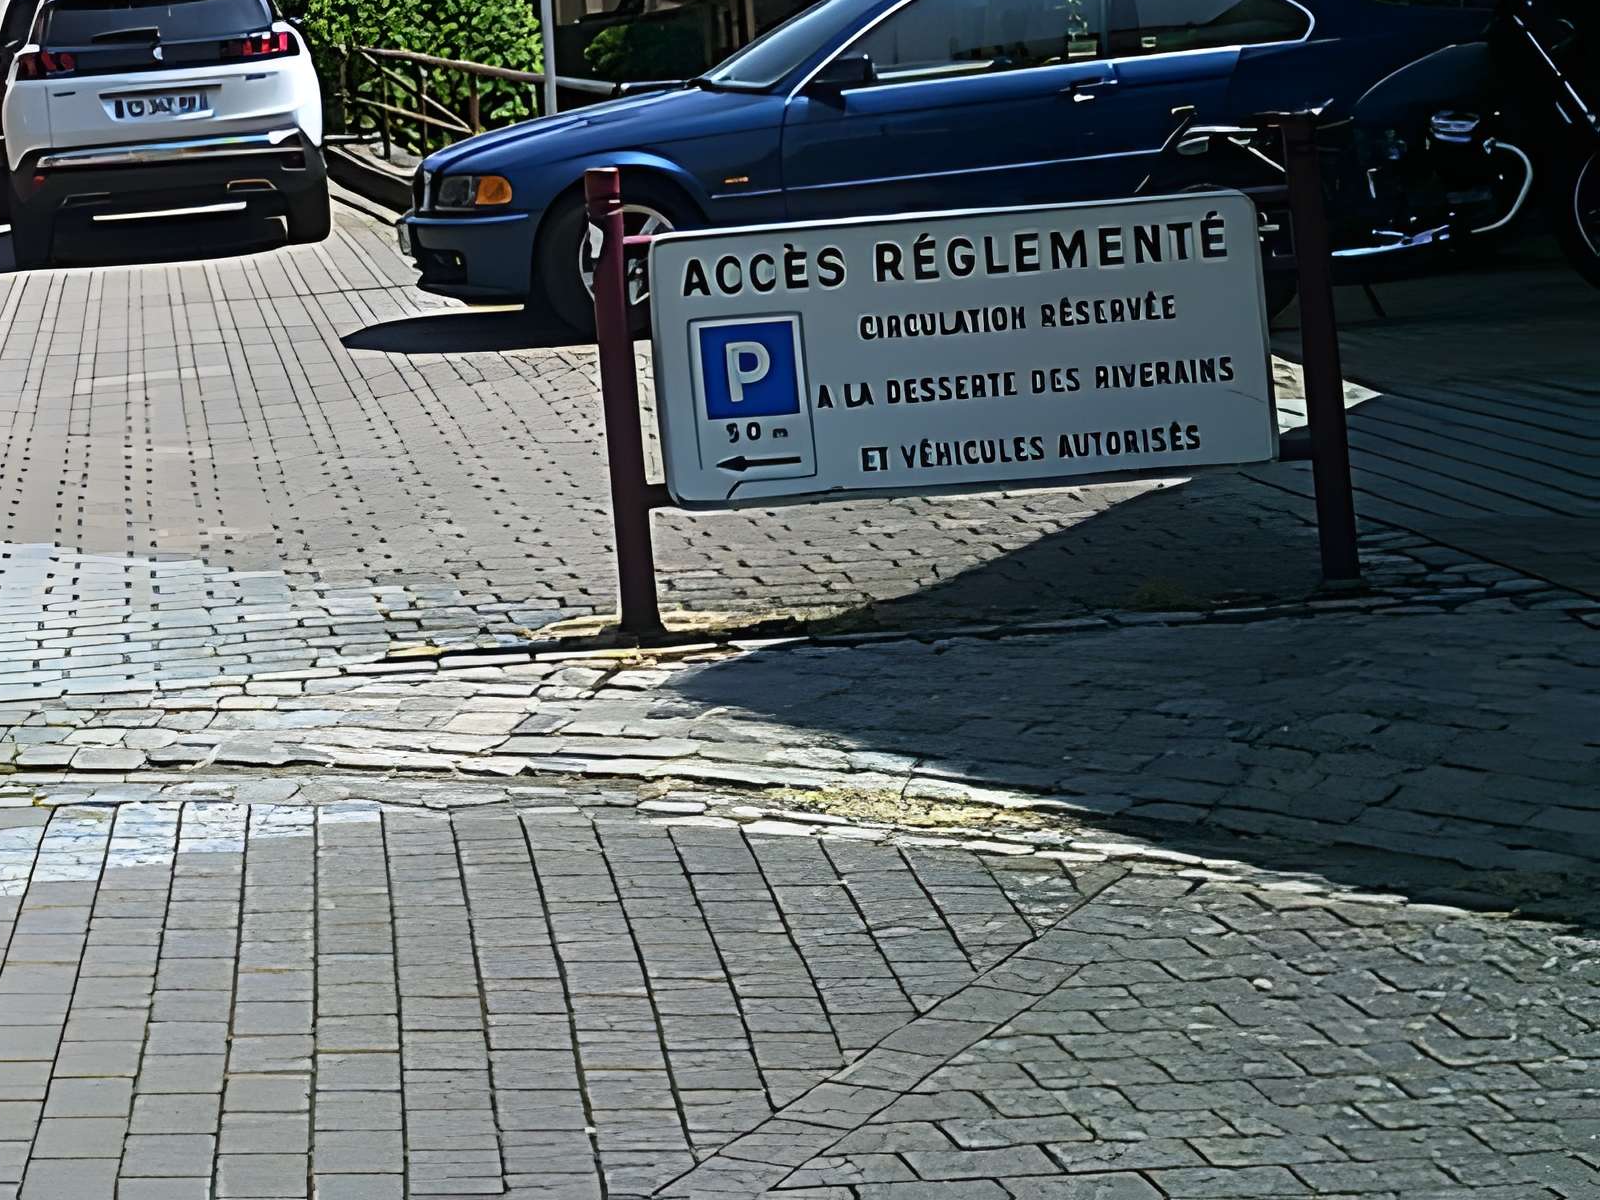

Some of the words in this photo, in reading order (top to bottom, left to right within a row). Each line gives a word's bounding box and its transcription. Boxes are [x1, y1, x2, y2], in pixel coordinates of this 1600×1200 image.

[682, 243, 848, 297] ACCÈS
[874, 211, 1228, 283] RÉGLEMENTÉ
[859, 305, 1027, 341] CIRCULATION
[725, 341, 771, 403] P
[844, 382, 875, 408] LA
[886, 371, 1018, 405] DESSERTE
[1031, 367, 1081, 395] DES
[1094, 356, 1235, 390] RIVERAINS
[861, 446, 889, 472] ET
[901, 437, 1045, 470] VÉHICULES
